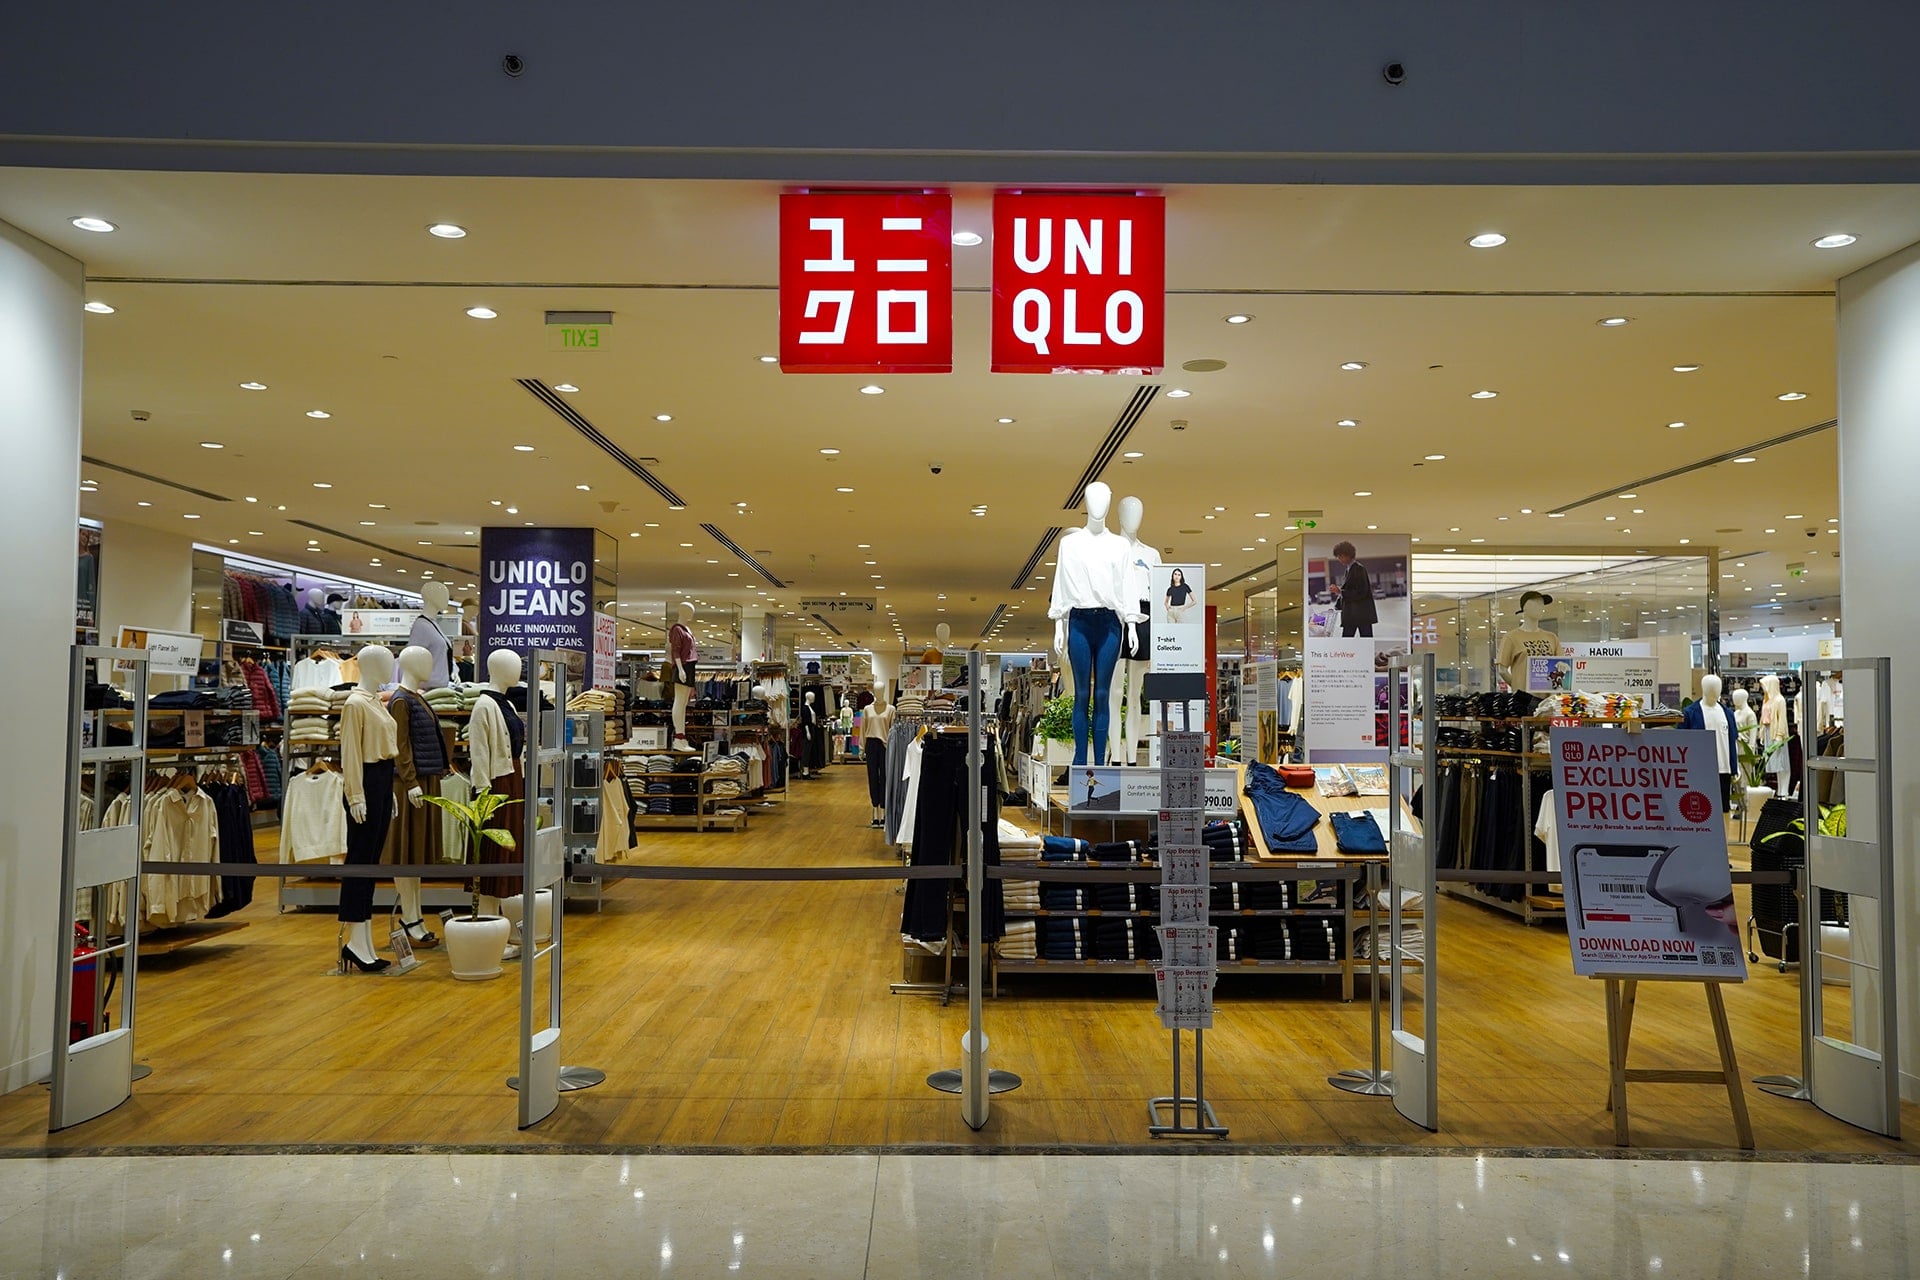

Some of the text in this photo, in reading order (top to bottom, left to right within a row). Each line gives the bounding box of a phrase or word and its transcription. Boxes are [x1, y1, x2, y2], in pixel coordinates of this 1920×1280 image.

[804, 218, 927, 272] ユニ
[1013, 218, 1132, 275] UNI
[799, 290, 928, 344] クロ
[1012, 288, 1144, 355] QLO
[489, 560, 587, 588] UNIQLO
[488, 589, 586, 616] JEANS
[495, 624, 578, 634] MAKE INNOVATION.
[488, 637, 585, 647] CREATE NEW JEANS.
[1589, 647, 1623, 657] HARUKI
[1576, 661, 1587, 670] UT
[1564, 743, 1581, 751] UNI
[1565, 751, 1582, 760] QLO
[1587, 744, 1689, 764] APP-ONLY
[1564, 766, 1690, 789] EXCLUSIVE
[1565, 791, 1665, 822] PRICE
[1593, 823, 1603, 831] App
[1579, 937, 1695, 953] DOWNLOAD NOW
